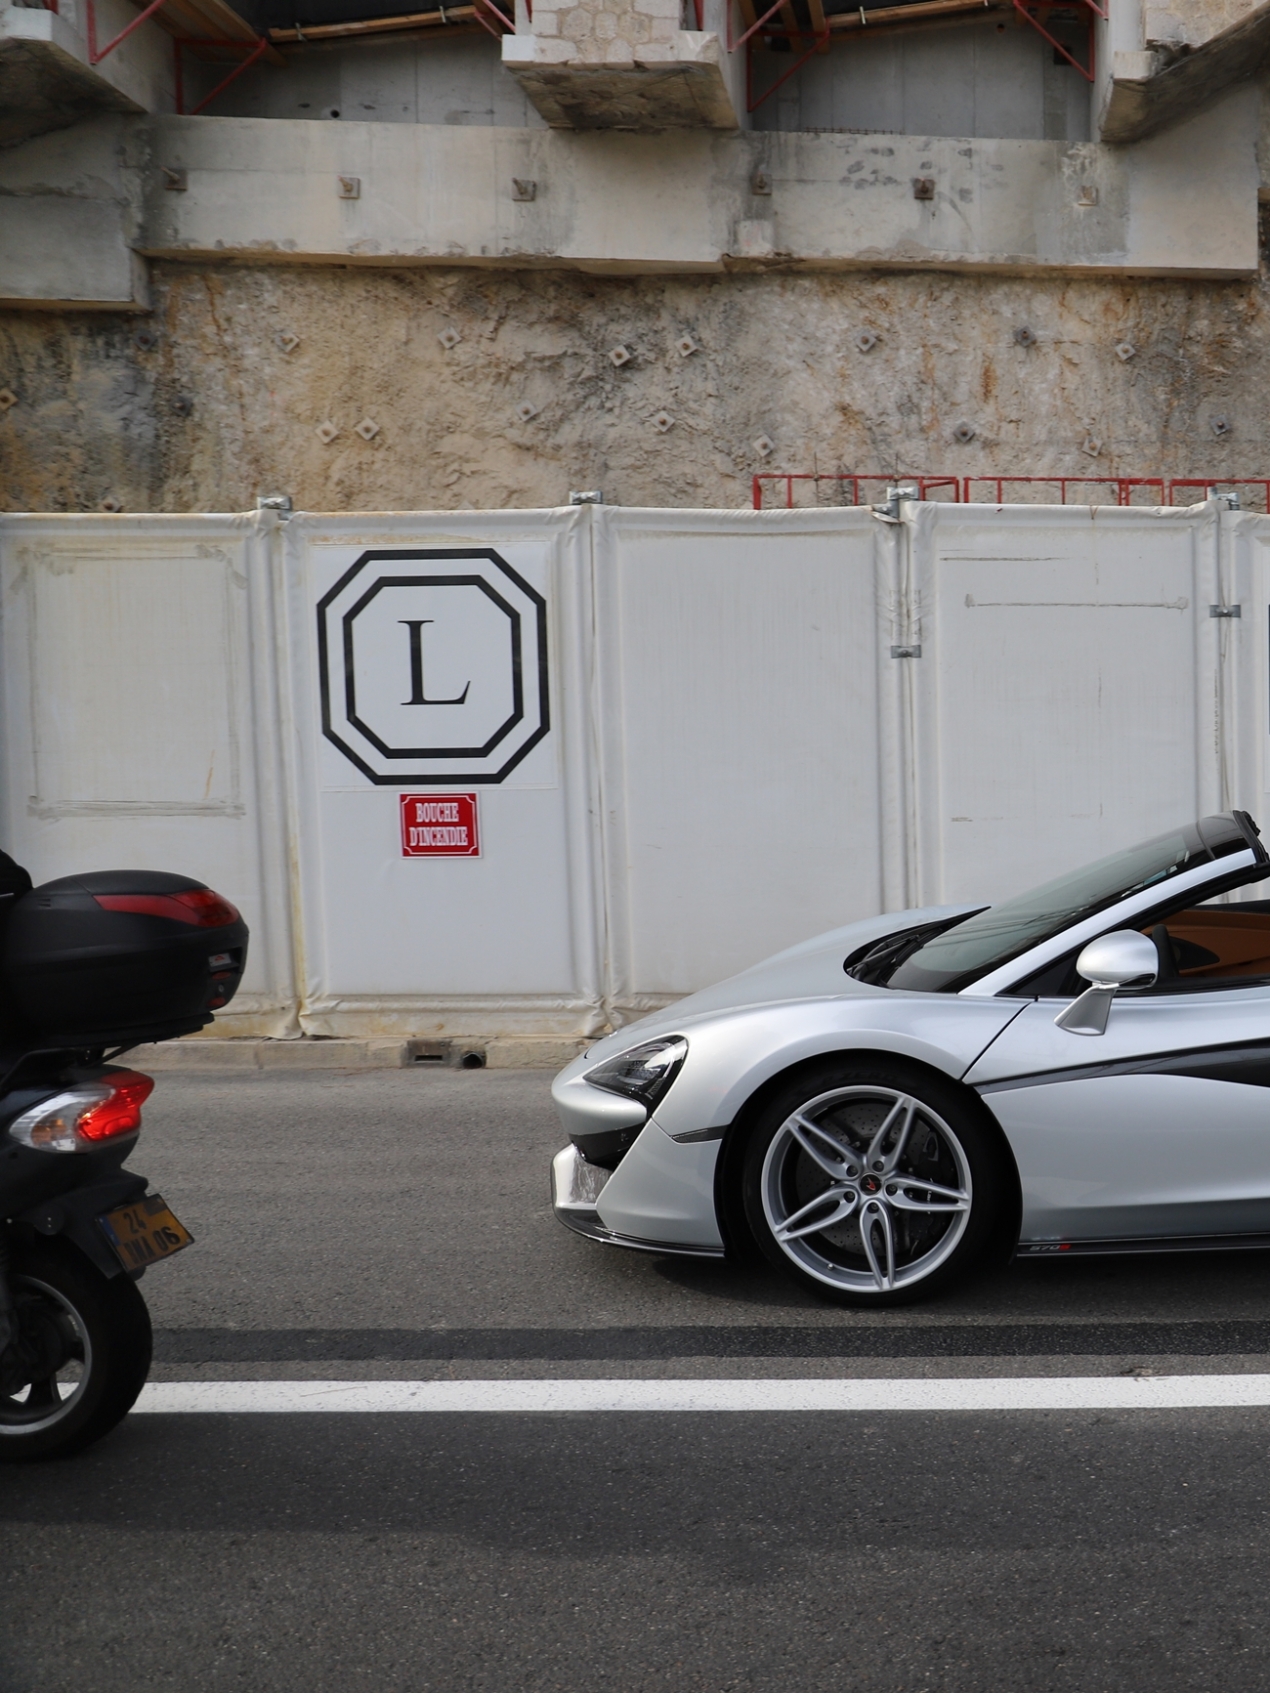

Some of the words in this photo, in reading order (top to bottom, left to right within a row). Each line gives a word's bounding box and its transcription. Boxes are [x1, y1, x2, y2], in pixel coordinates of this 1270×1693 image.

[398, 619, 471, 706] L
[415, 802, 460, 823] BOUCHE
[409, 826, 469, 847] D'INCENDIE
[122, 1208, 148, 1235] 24
[152, 1226, 181, 1253] 06
